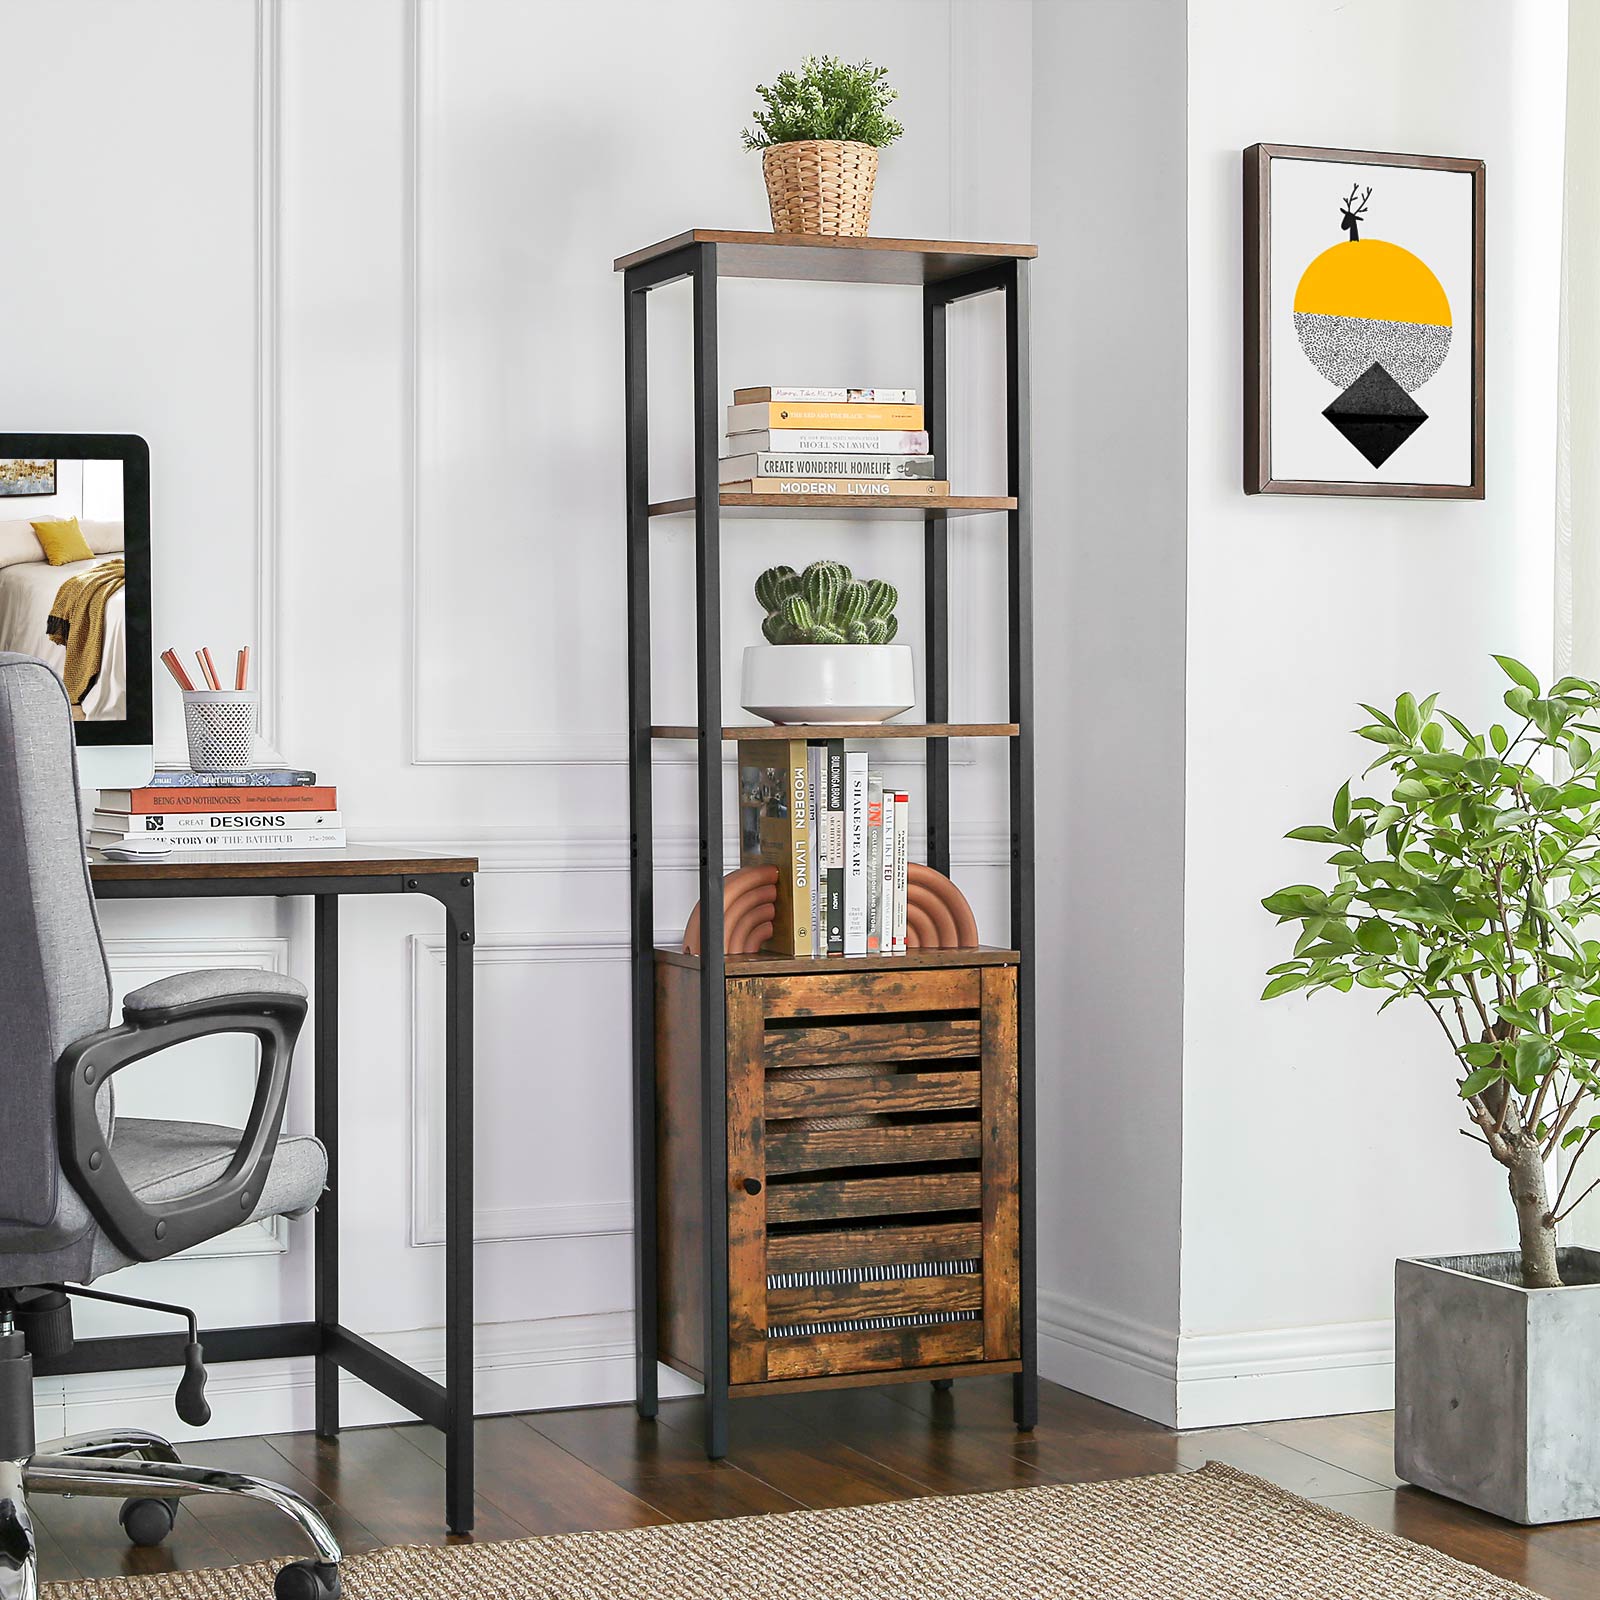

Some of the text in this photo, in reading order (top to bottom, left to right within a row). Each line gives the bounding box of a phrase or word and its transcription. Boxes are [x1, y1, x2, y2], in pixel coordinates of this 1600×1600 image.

[764, 460, 890, 474] CREATE WONDERFUL HOMELIFE
[780, 482, 890, 494] MODERN LIVING
[831, 755, 840, 783] BUILDING
[153, 795, 241, 805] BEING AND NOTHINGNESS
[820, 769, 828, 826] FURNITURE
[831, 788, 840, 808] BRAND
[210, 815, 286, 827] DESIGNS
[868, 801, 882, 827] IN!
[794, 767, 807, 887] MODERN LIVING
[853, 780, 862, 876] SHAKESPEARE
[169, 836, 202, 845] STORY
[205, 836, 219, 844] OF
[221, 836, 243, 844] THE
[246, 835, 293, 844] BATHTUB
[884, 864, 892, 881] TED
